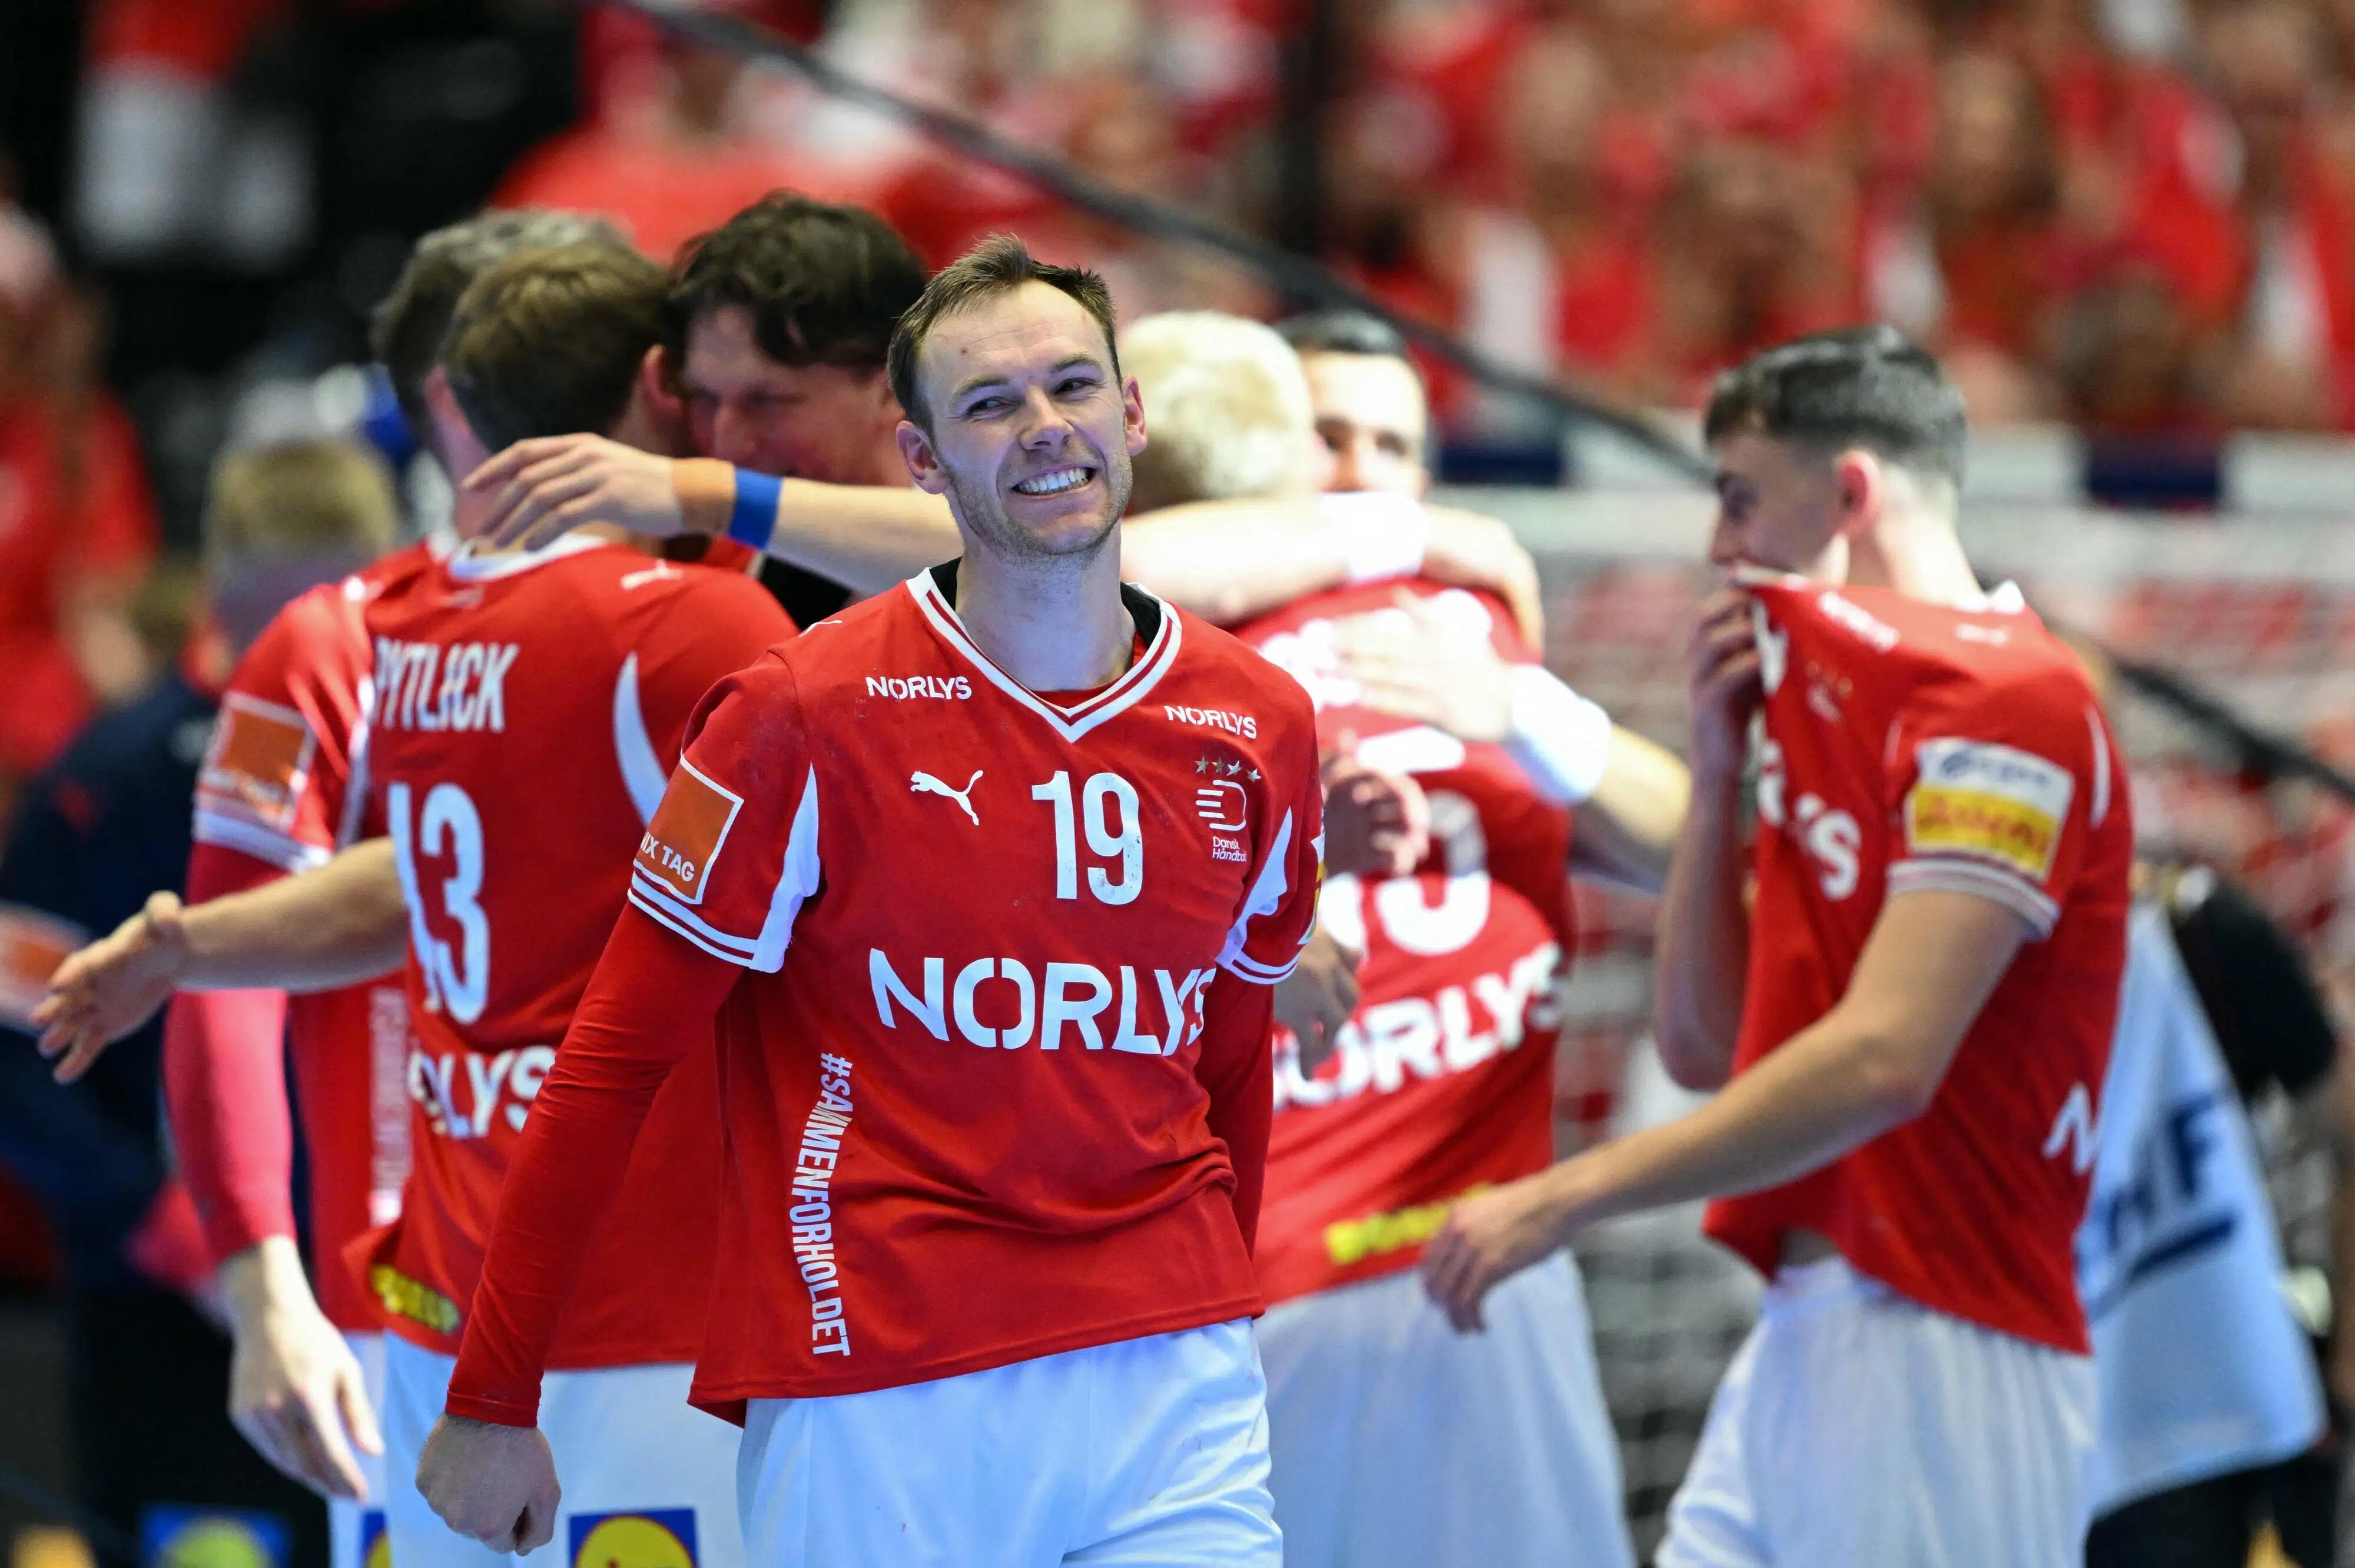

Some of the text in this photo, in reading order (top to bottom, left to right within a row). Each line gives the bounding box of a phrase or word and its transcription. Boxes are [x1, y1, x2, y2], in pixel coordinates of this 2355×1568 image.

[865, 676, 973, 699] NORLYS
[1163, 705, 1257, 739] NORLYS
[1031, 770, 1143, 905] 19
[1212, 836, 1240, 850] Dansk
[661, 845, 695, 882] TAG
[868, 948, 1217, 1057] NORLYS
[789, 1052, 854, 1357] #SAMMENFORHOLDET
